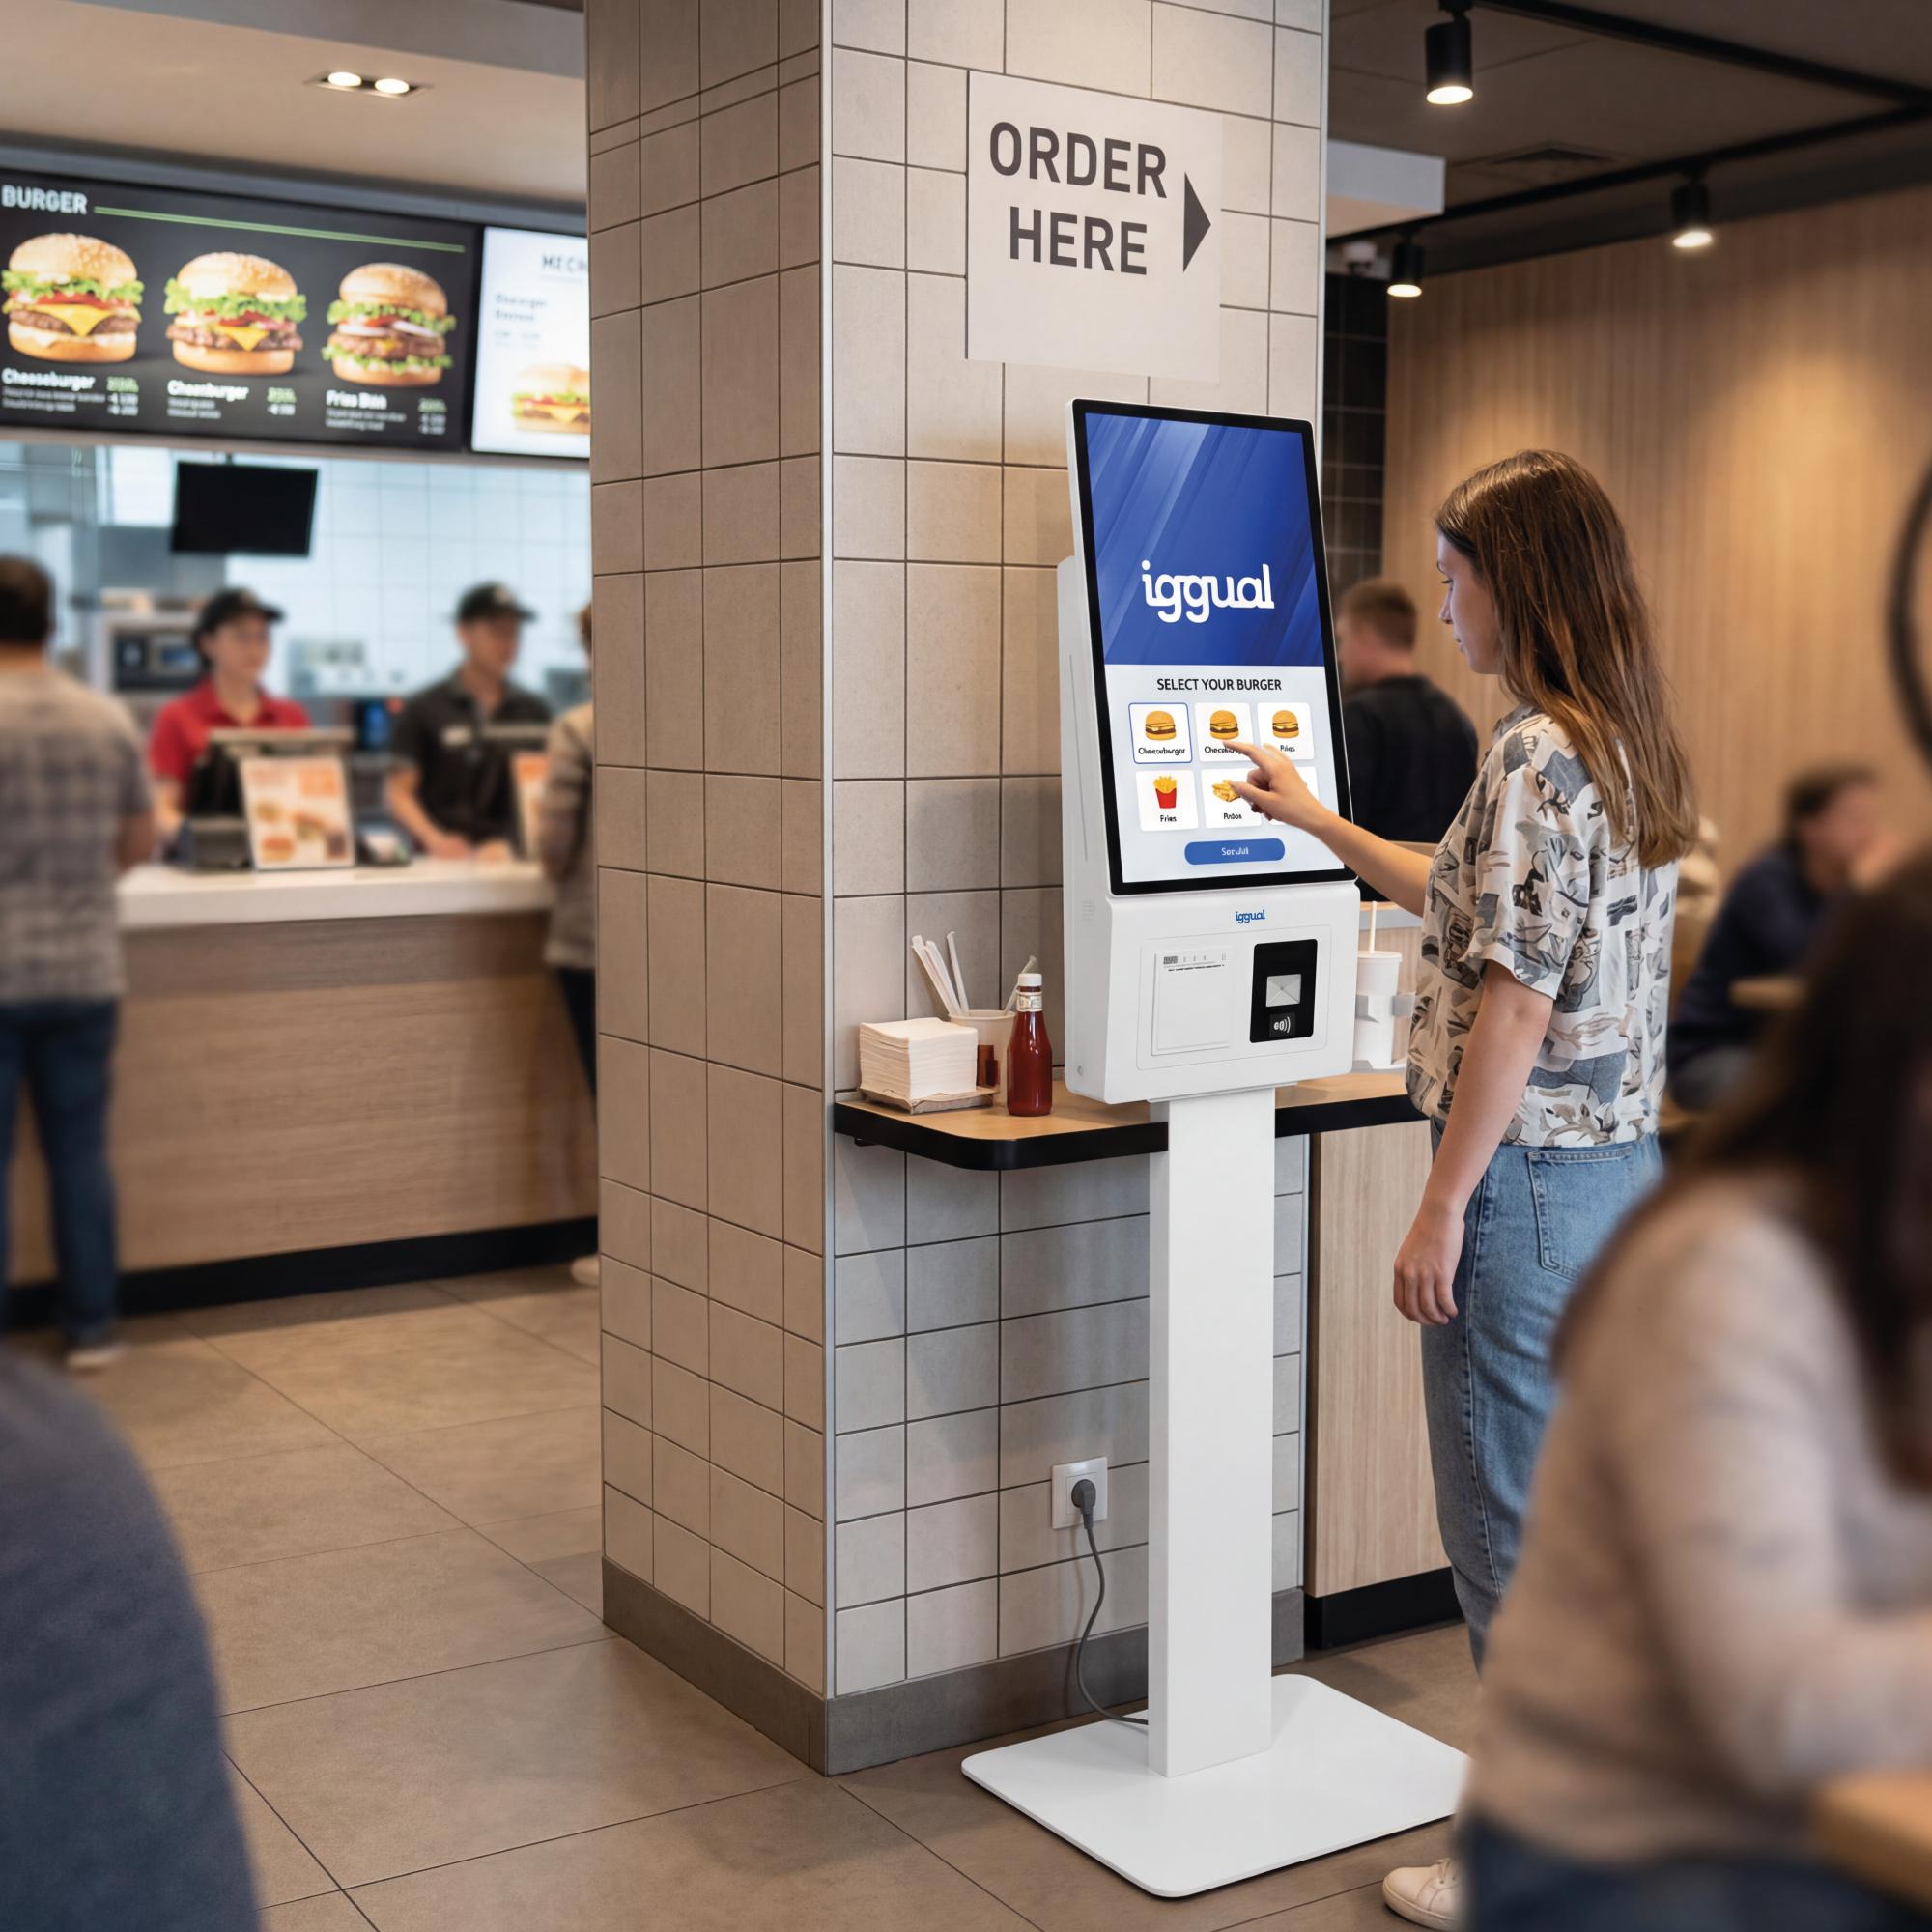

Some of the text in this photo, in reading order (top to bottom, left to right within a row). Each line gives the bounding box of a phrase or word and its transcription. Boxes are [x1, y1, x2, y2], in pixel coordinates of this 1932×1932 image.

[989, 121, 1168, 199] ORDER
[1, 185, 88, 215] BURGER
[1009, 206, 1148, 275] HERE
[1141, 559, 1275, 624] iggual
[1157, 678, 1283, 691] SELECT YOUR BURGER
[1235, 909, 1266, 924] iggual
